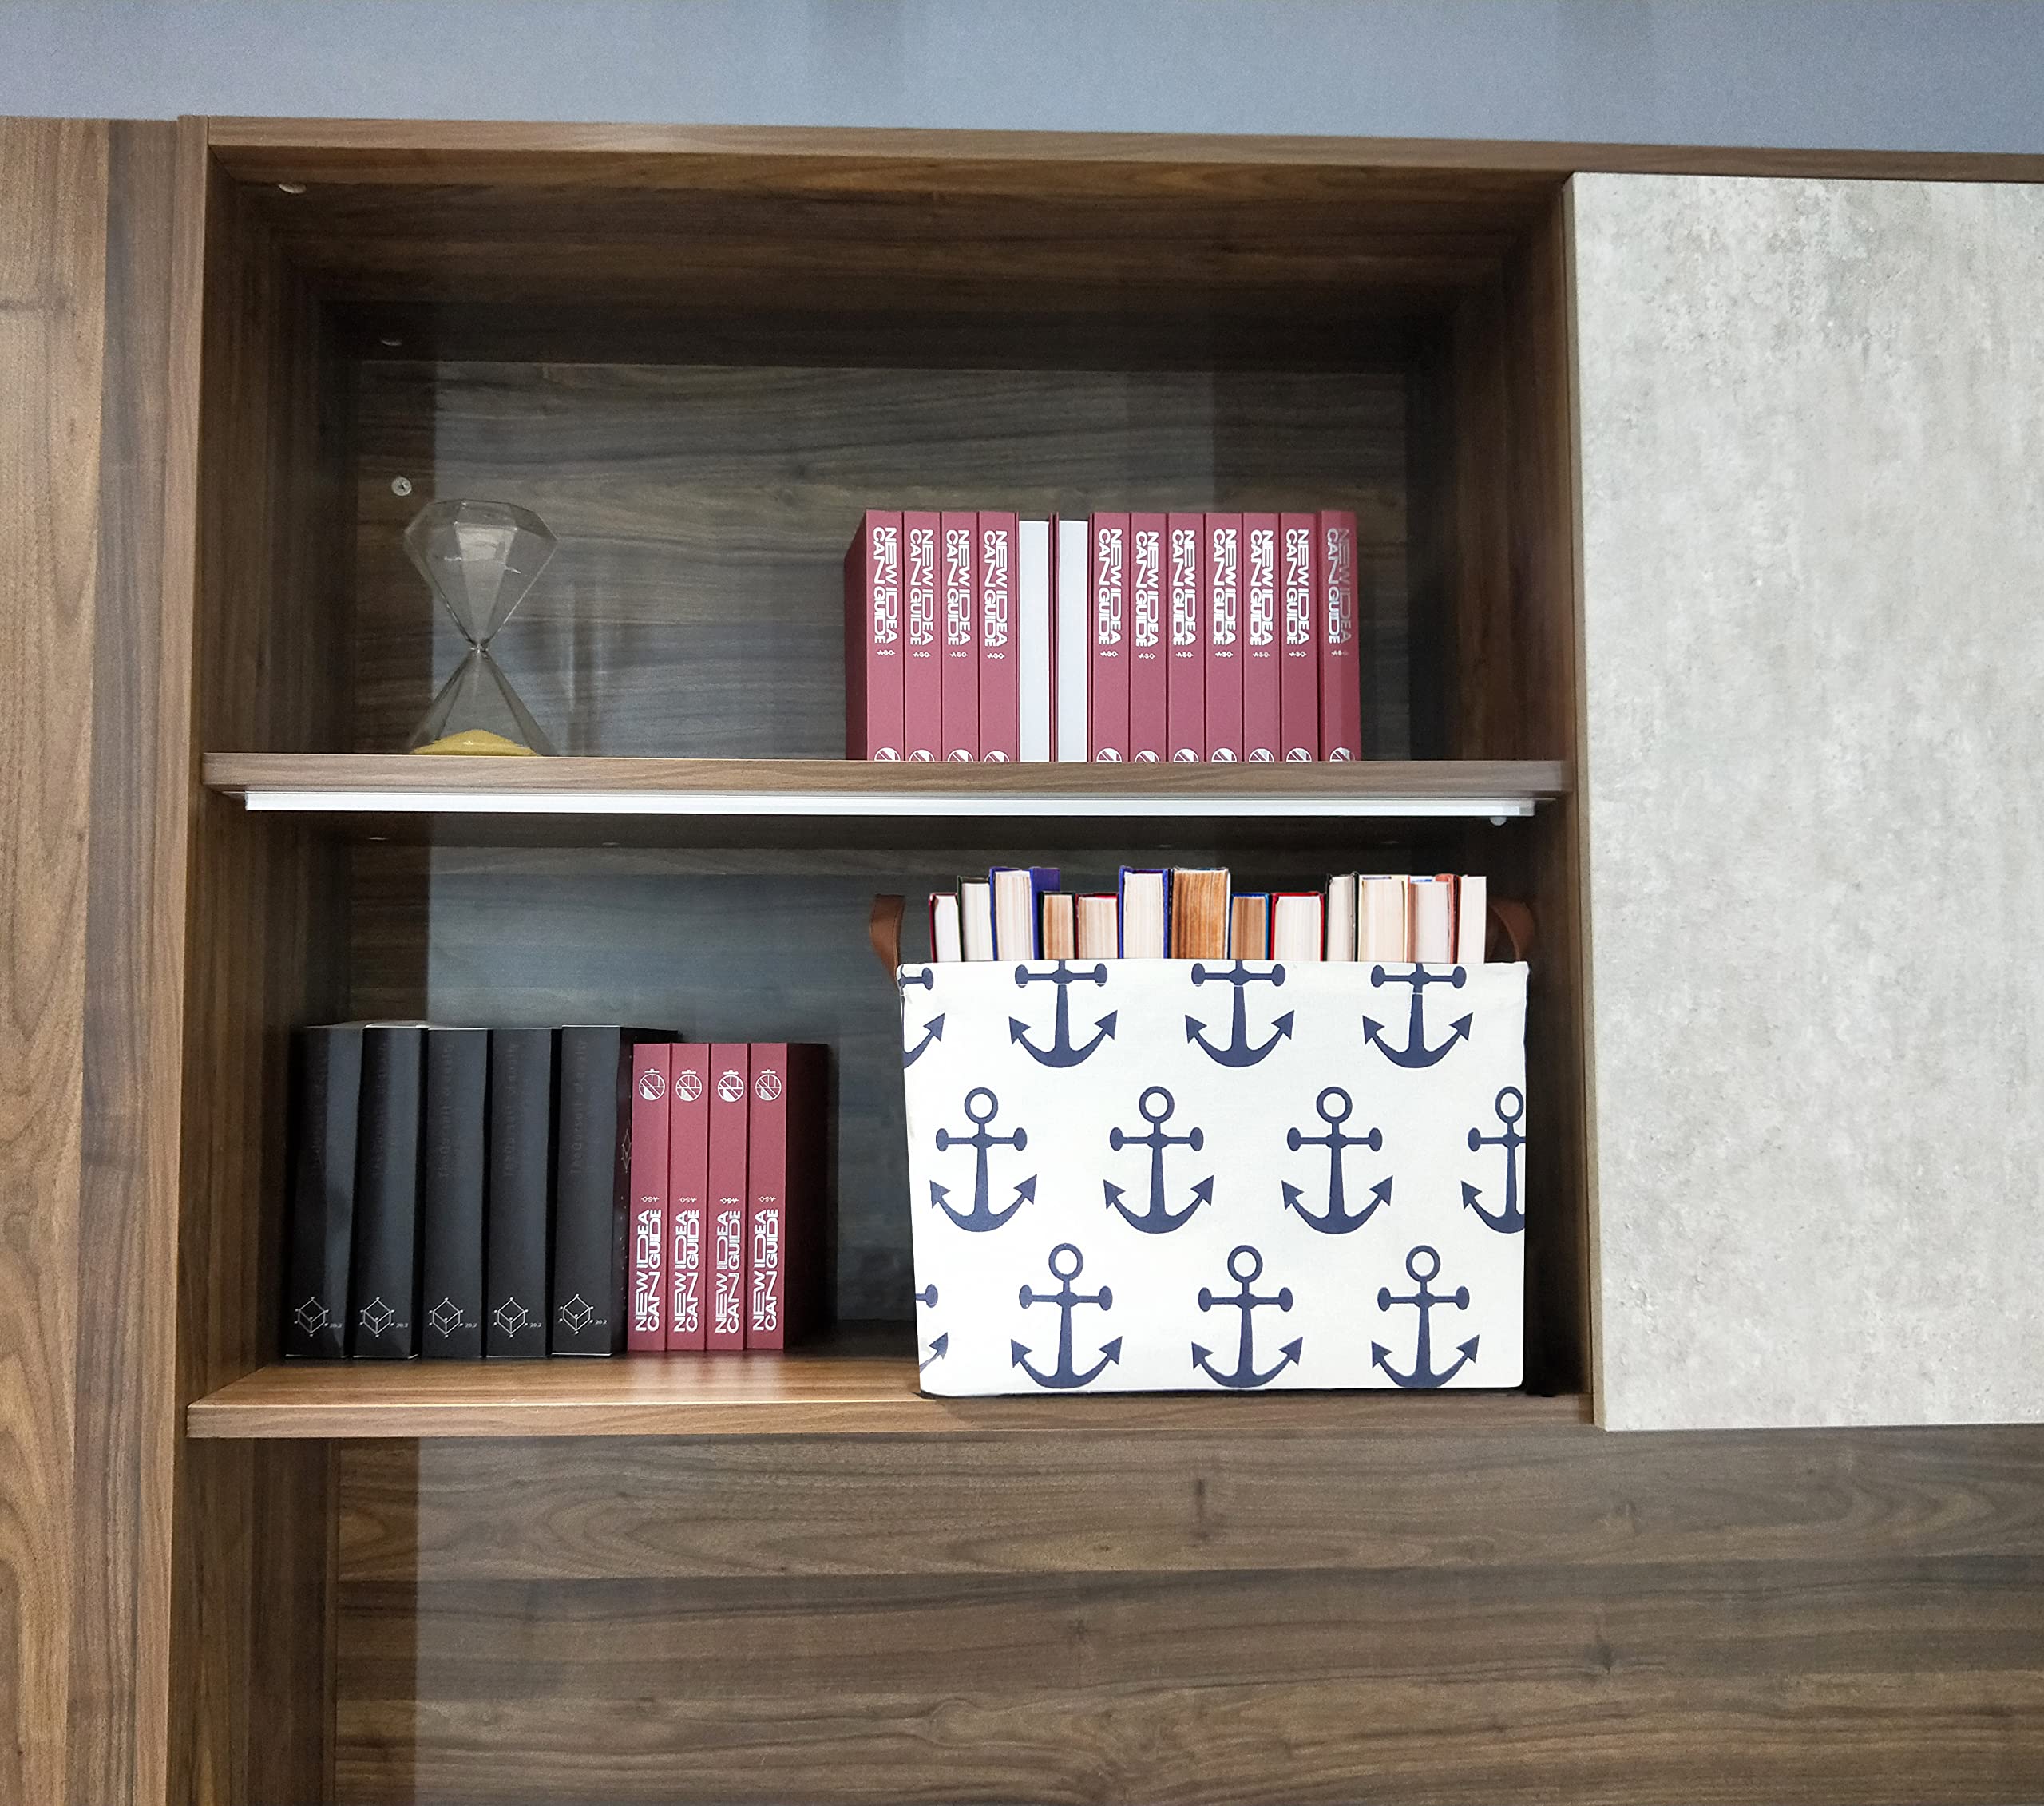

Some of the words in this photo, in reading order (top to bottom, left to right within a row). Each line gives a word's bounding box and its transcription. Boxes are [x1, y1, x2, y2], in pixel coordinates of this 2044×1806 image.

[873, 526, 885, 585] CAN
[885, 526, 897, 585] NEW
[910, 529, 921, 587] CAN
[921, 529, 933, 587] NEW
[947, 529, 958, 587] CAN
[958, 529, 970, 587] NEW
[984, 530, 996, 588] CAN
[996, 530, 1008, 588] NEW
[1099, 529, 1110, 586] CAN
[1110, 529, 1122, 587] NEW
[1135, 530, 1147, 588] CAN
[1147, 530, 1159, 588] NEW
[1172, 529, 1184, 587] CAN
[1184, 529, 1196, 588] NEW
[1213, 529, 1225, 586] CAN
[1225, 529, 1237, 587] NEW
[1250, 529, 1262, 587] CAN
[1262, 529, 1274, 587] NEW
[1286, 529, 1297, 587] CAN
[1297, 529, 1309, 588] NEW
[1327, 528, 1339, 585] CAN
[1339, 528, 1351, 585] NEW
[873, 586, 885, 644] GUIDE
[885, 586, 897, 644] IDEA
[910, 588, 922, 646] GUIDE
[921, 588, 933, 646] IDEA
[947, 588, 959, 646] GUIDE
[958, 588, 970, 645] IDEA
[984, 589, 996, 648] GUIDE
[996, 589, 1008, 647] IDEA
[1099, 587, 1111, 645] GUIDE
[1110, 587, 1122, 644] IDEA
[1135, 589, 1147, 648] GUIDE
[1147, 588, 1159, 647] IDEA
[1172, 588, 1185, 646] GUIDE
[1184, 588, 1196, 646] IDEA
[1213, 588, 1226, 646] GUIDE
[1225, 587, 1237, 645] IDEA
[1250, 588, 1262, 646] GUIDE
[1262, 588, 1274, 646] IDEA
[1286, 588, 1298, 647] GUIDE
[1297, 588, 1309, 646] IDEA
[1327, 586, 1340, 644] GUIDE
[1339, 586, 1351, 644] IDEA
[637, 1210, 650, 1269] IDEA
[648, 1209, 662, 1269] GUIDE
[675, 1210, 688, 1269] IDEA
[687, 1210, 699, 1270] GUIDE
[717, 1211, 729, 1269] IDEA
[728, 1210, 741, 1270] GUIDE
[754, 1210, 766, 1268] IDEA
[766, 1209, 778, 1269] GUIDE
[636, 1271, 648, 1332] NEW
[648, 1272, 660, 1333] CAN
[674, 1273, 687, 1333] NEW
[686, 1272, 698, 1333] CAN
[715, 1273, 728, 1333] NEW
[727, 1273, 740, 1333] CAN
[753, 1271, 766, 1332] NEW
[765, 1271, 778, 1331] CAN
